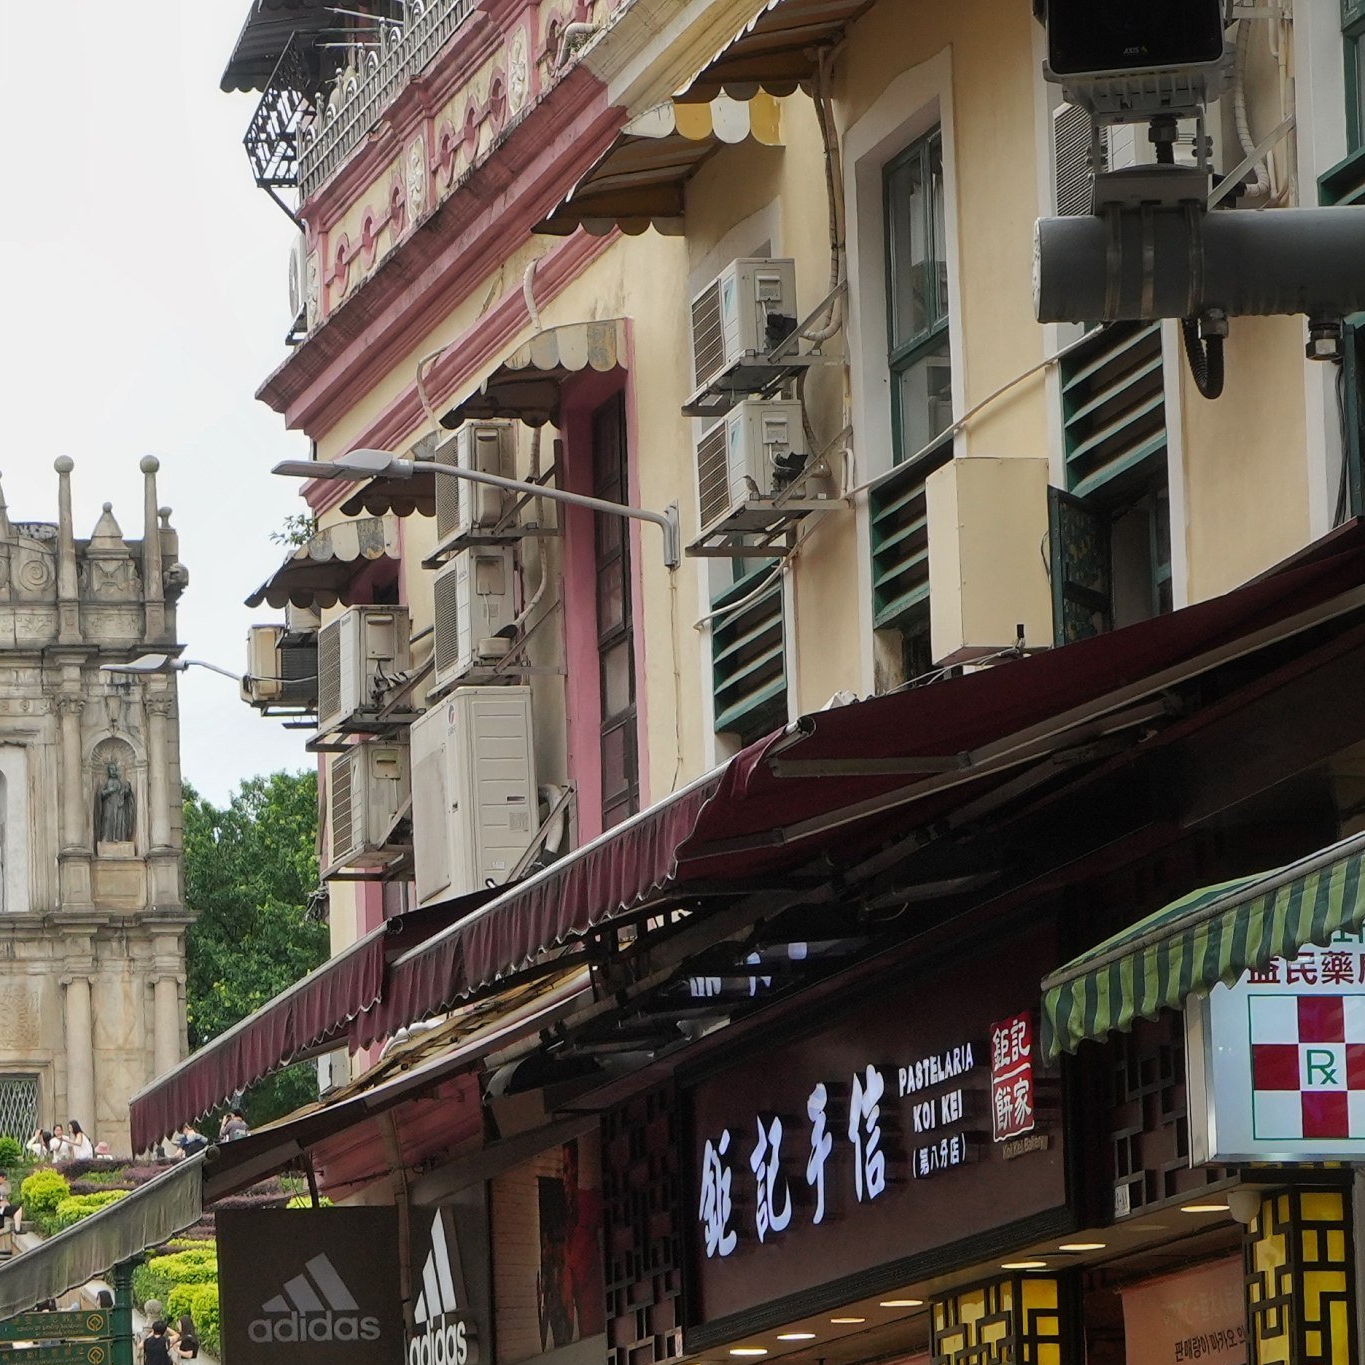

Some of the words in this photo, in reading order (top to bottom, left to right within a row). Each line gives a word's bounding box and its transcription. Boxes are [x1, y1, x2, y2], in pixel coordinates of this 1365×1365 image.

[898, 1043, 974, 1097] PASTELARIA
[913, 1100, 935, 1132] KOI
[941, 1089, 963, 1125] KEI
[248, 1310, 381, 1343] adidas
